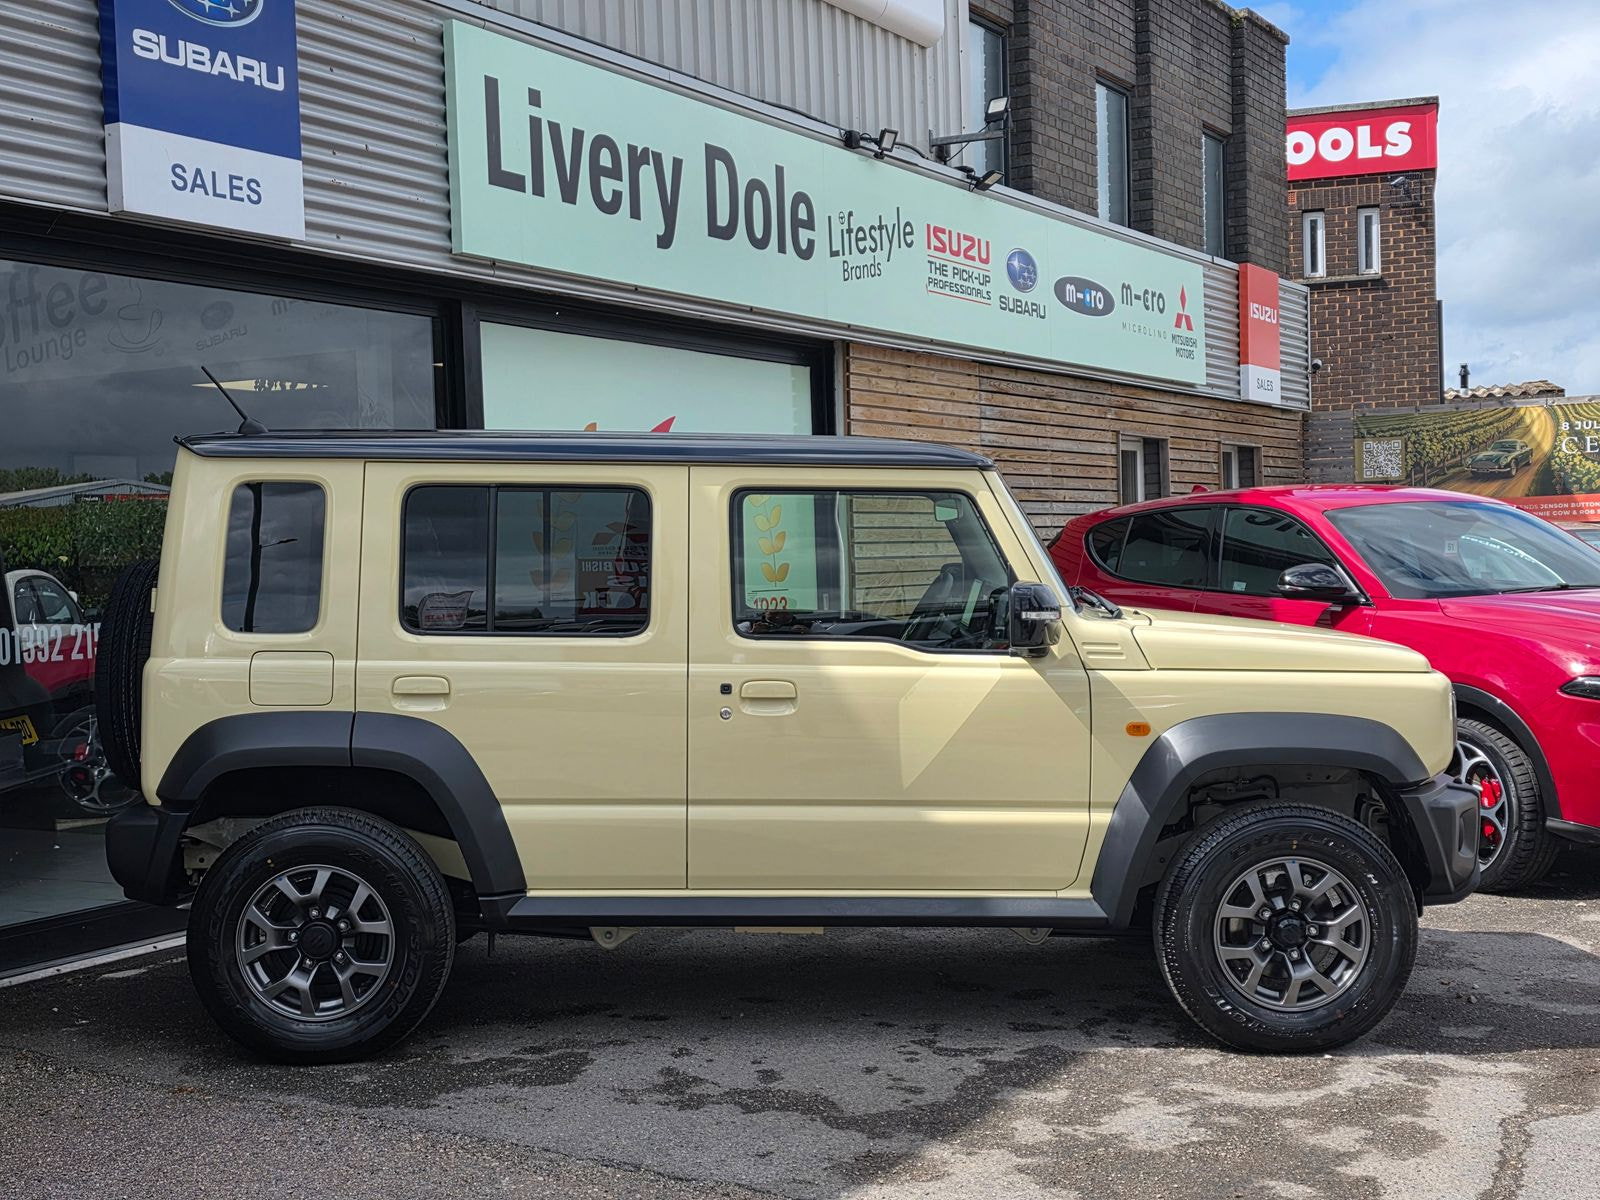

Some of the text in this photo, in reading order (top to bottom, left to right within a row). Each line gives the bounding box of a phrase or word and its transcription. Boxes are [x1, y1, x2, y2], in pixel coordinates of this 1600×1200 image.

[132, 29, 285, 92] SUBARU
[483, 74, 816, 261] Livery Dole
[171, 163, 263, 205] SALES
[827, 206, 915, 262] Lifestyle
[926, 223, 991, 265] ISUZU
[842, 255, 882, 282] Brands
[927, 260, 991, 287] THE PICK-UP
[927, 277, 992, 300] PROFESSIONALS
[999, 294, 1047, 320] SUBARU
[1250, 301, 1278, 325] ISUZU
[195, 324, 248, 351] SUBARU
[1122, 321, 1168, 340] MICROLINO
[1171, 333, 1198, 348] MITSUBISHI
[5, 328, 87, 373] Lounge
[1175, 347, 1195, 360] MOTORS
[1256, 377, 1274, 392] SALES
[1561, 421, 1570, 431] 8
[0, 624, 64, 666] 01392
